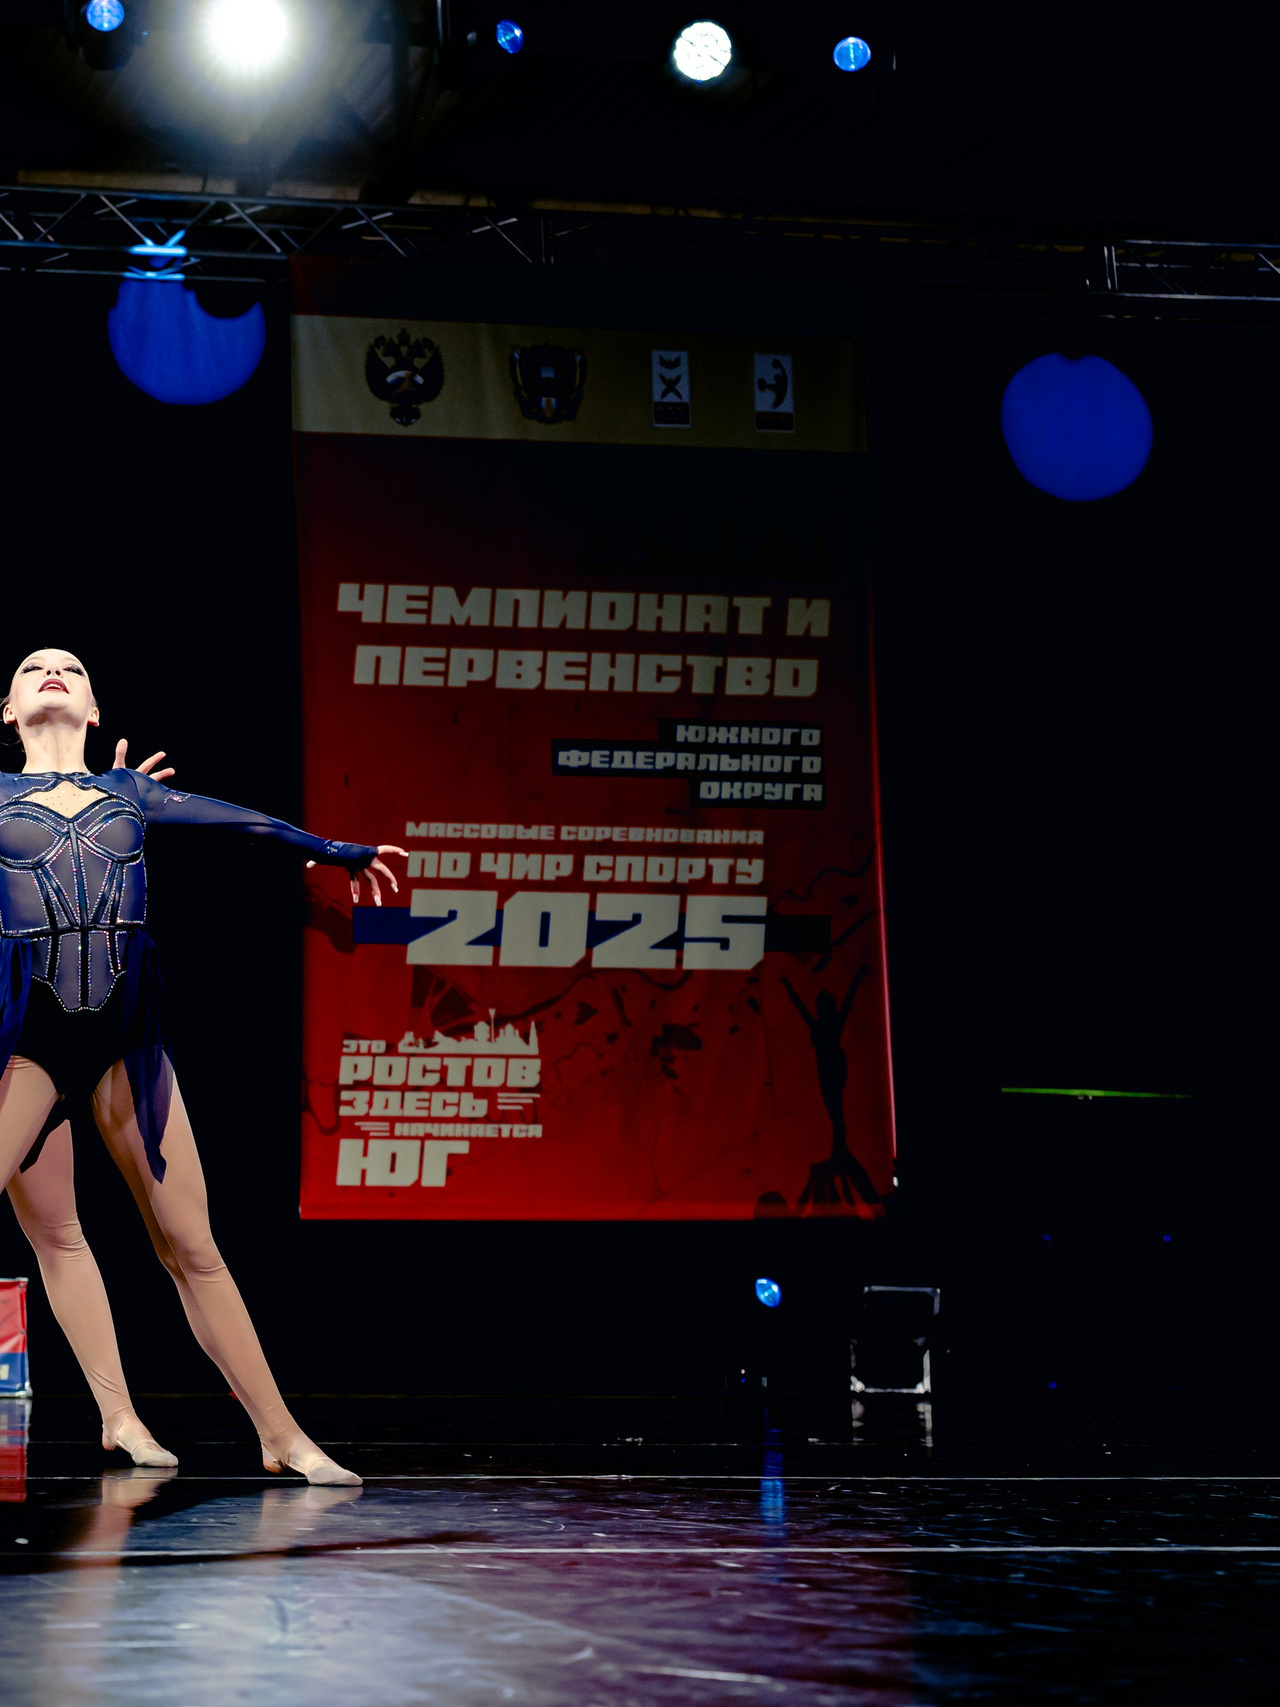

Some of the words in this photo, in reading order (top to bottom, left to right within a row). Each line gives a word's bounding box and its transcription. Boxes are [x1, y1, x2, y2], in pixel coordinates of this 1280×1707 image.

[337, 582, 772, 635] ЧЕМПИОНАТ
[786, 597, 831, 637] И
[353, 644, 819, 697] ПЕРВЕНСТВО
[676, 724, 821, 746] ЮЖНОГО
[557, 749, 821, 774] ФЕДЕРАЛЬНОГО
[699, 781, 822, 801] ОКРУГА
[405, 822, 555, 841] МАССОВЫЕ
[560, 826, 764, 845] СОРЕВНОВАНИЯ
[407, 851, 471, 878] ПО
[480, 852, 573, 880] ЧИР
[582, 855, 764, 884] СПОРТУ
[406, 889, 767, 971] 2025
[342, 1039, 386, 1053] ЭТО
[338, 1055, 541, 1087] РОСТОВ
[339, 1090, 488, 1118] ЗДЕСЬ
[394, 1122, 543, 1138] НАЧИНАЕТСЯ
[336, 1138, 470, 1187] ЮГ
